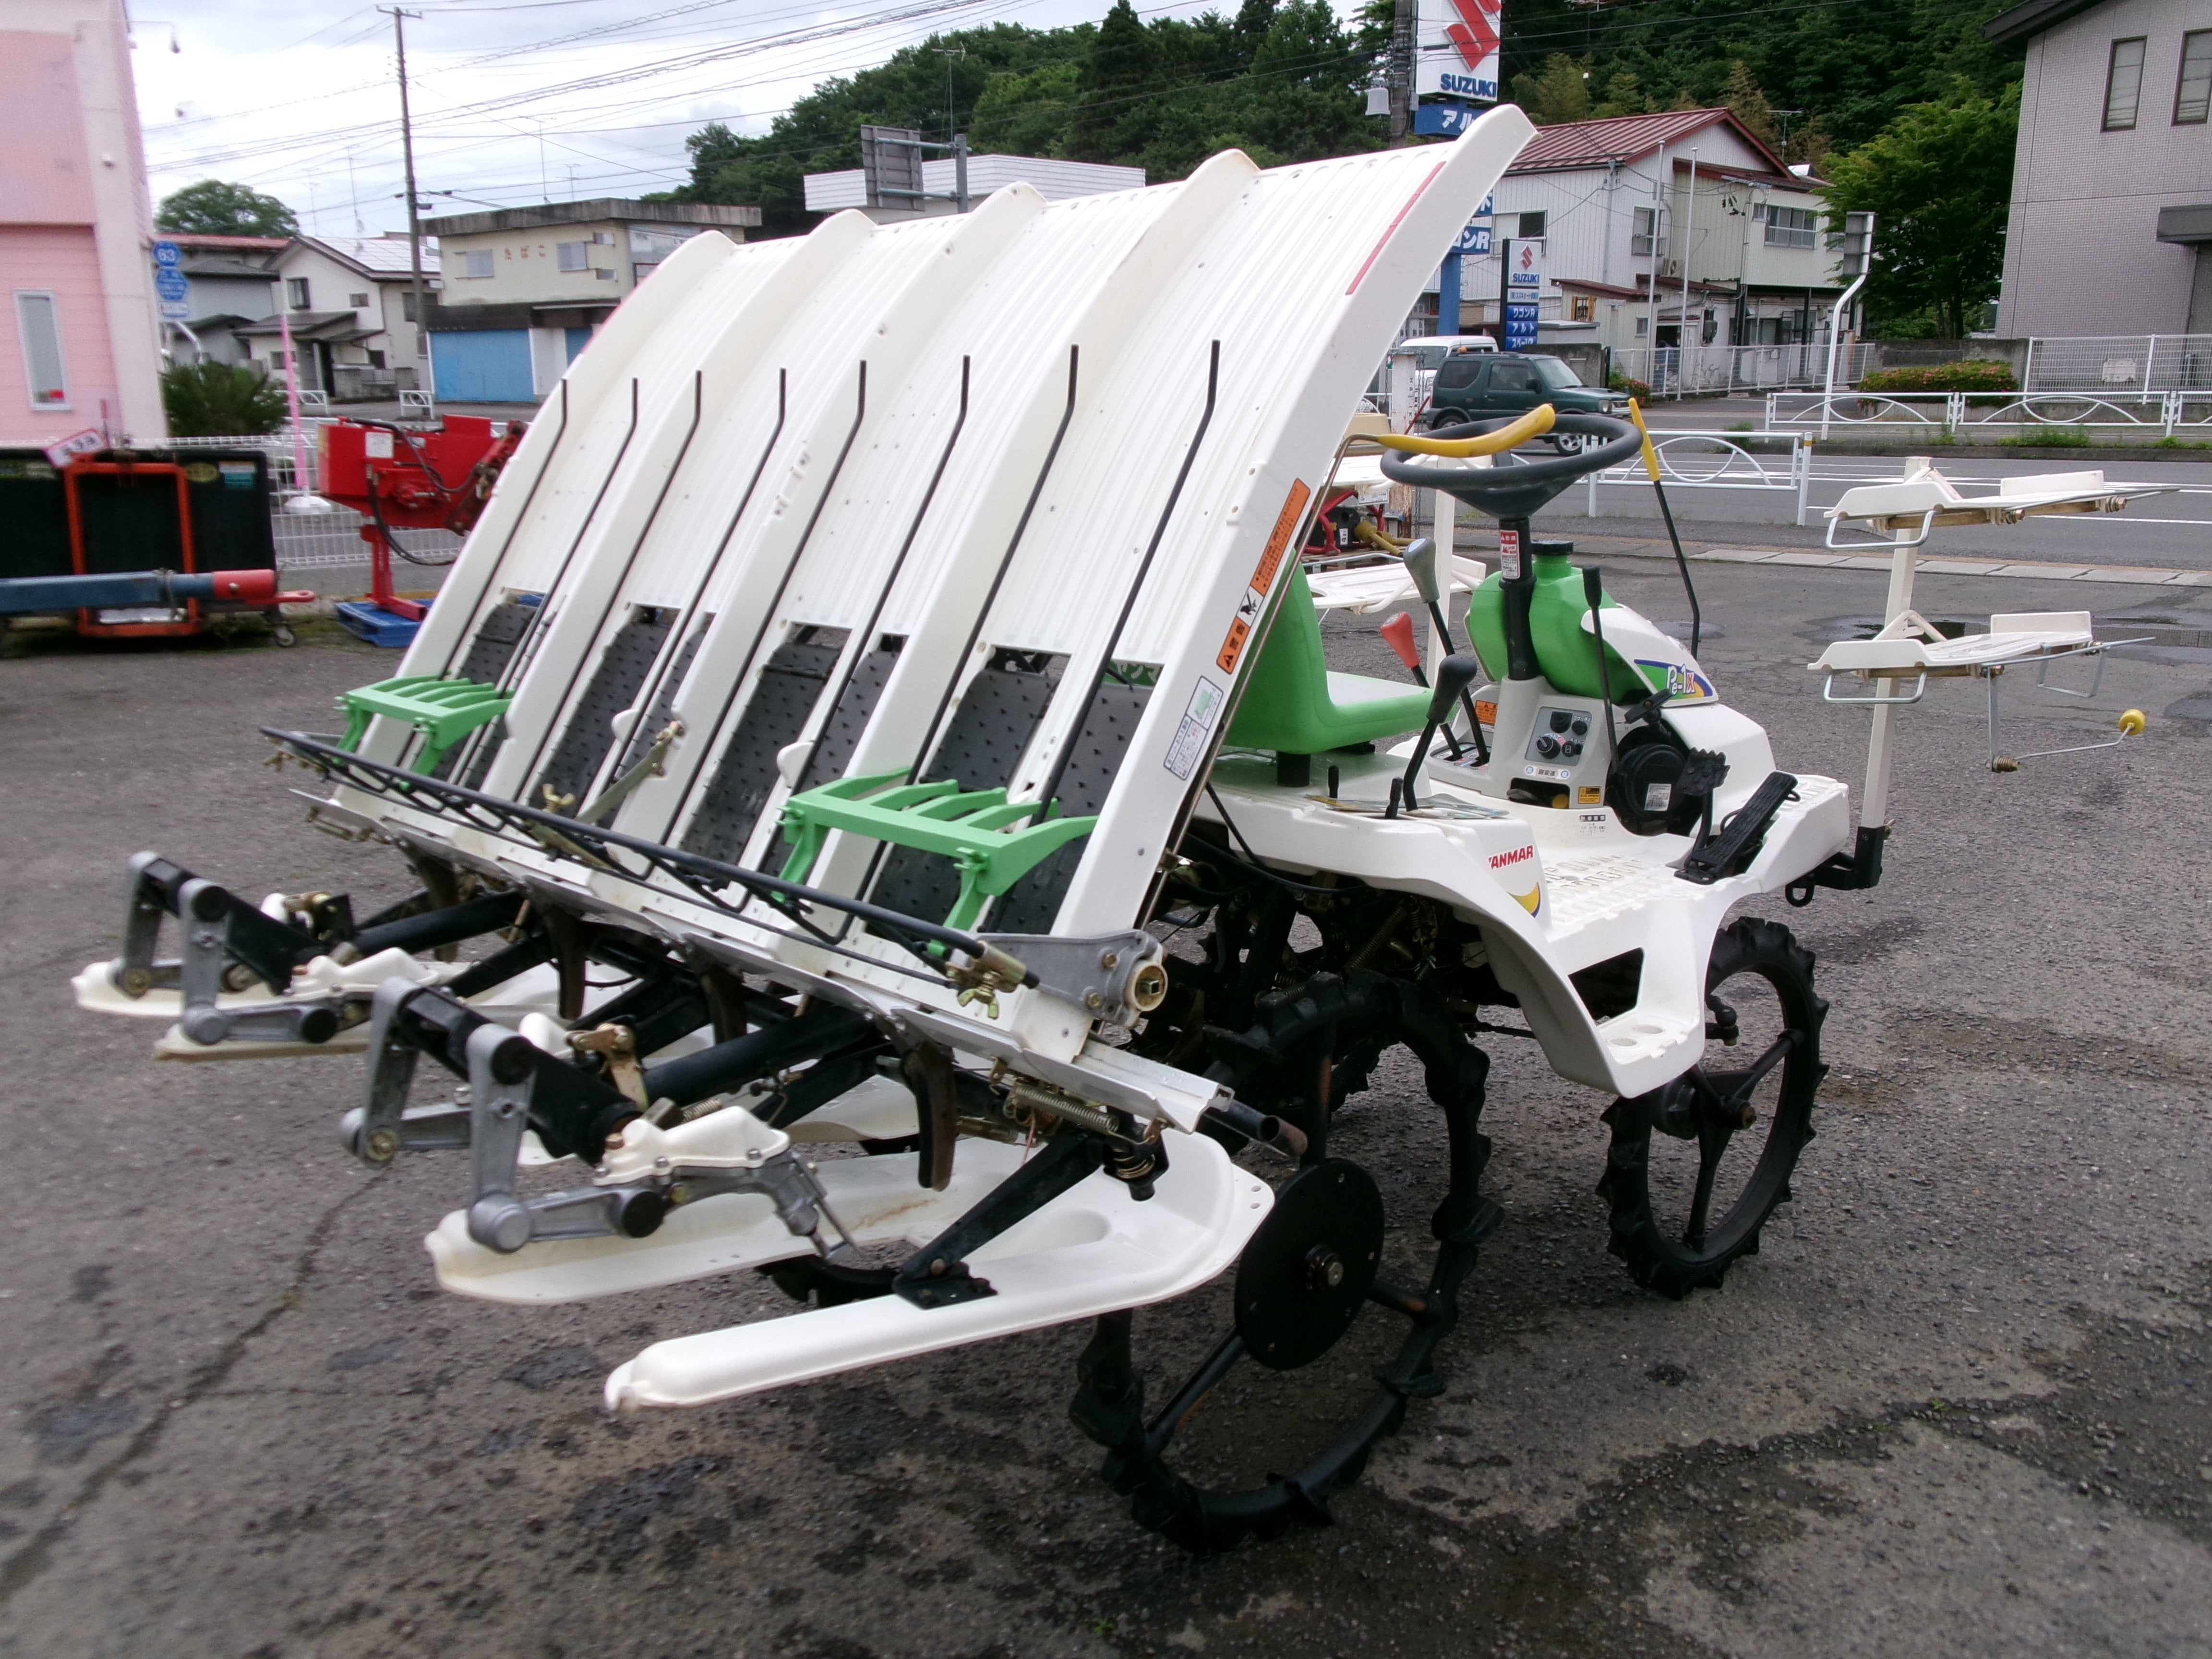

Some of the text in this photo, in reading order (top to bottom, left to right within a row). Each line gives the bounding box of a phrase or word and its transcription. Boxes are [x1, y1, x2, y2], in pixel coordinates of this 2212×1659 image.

[1440, 73, 1497, 97] SUZUKI
[1441, 109, 1475, 132] アル
[1513, 273, 1539, 283] SUZUKI
[1513, 307, 1535, 318] ワゴンR
[1513, 322, 1534, 334] アルト
